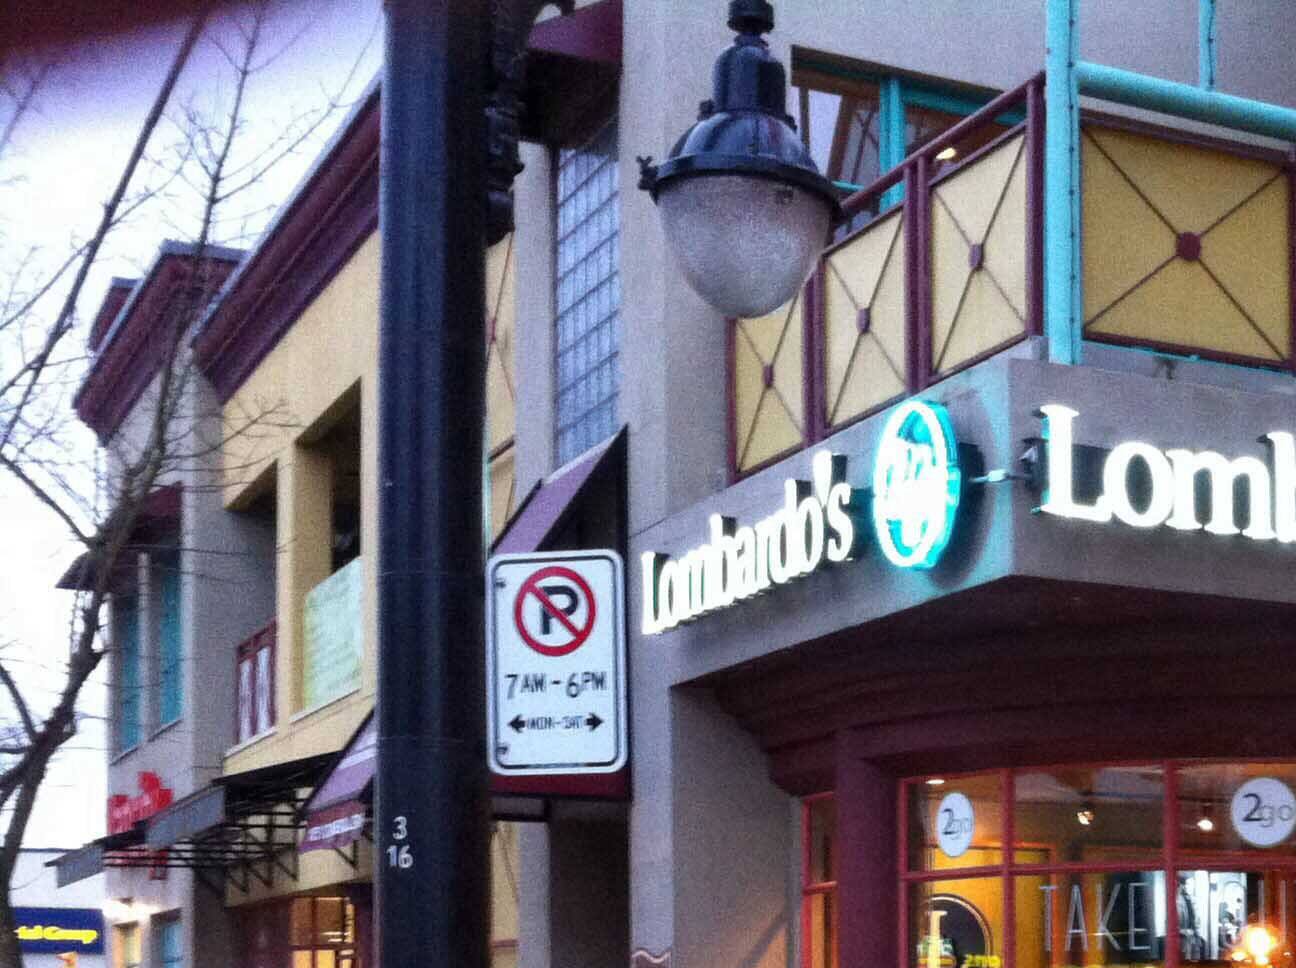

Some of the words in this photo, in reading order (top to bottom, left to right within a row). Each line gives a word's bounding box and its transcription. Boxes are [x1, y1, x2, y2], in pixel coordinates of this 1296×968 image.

[639, 450, 854, 636] Lombardo's
[392, 816, 408, 840] 3
[1241, 792, 1295, 828] 2go
[386, 845, 414, 869] 16
[1038, 882, 1152, 951] TAKE
